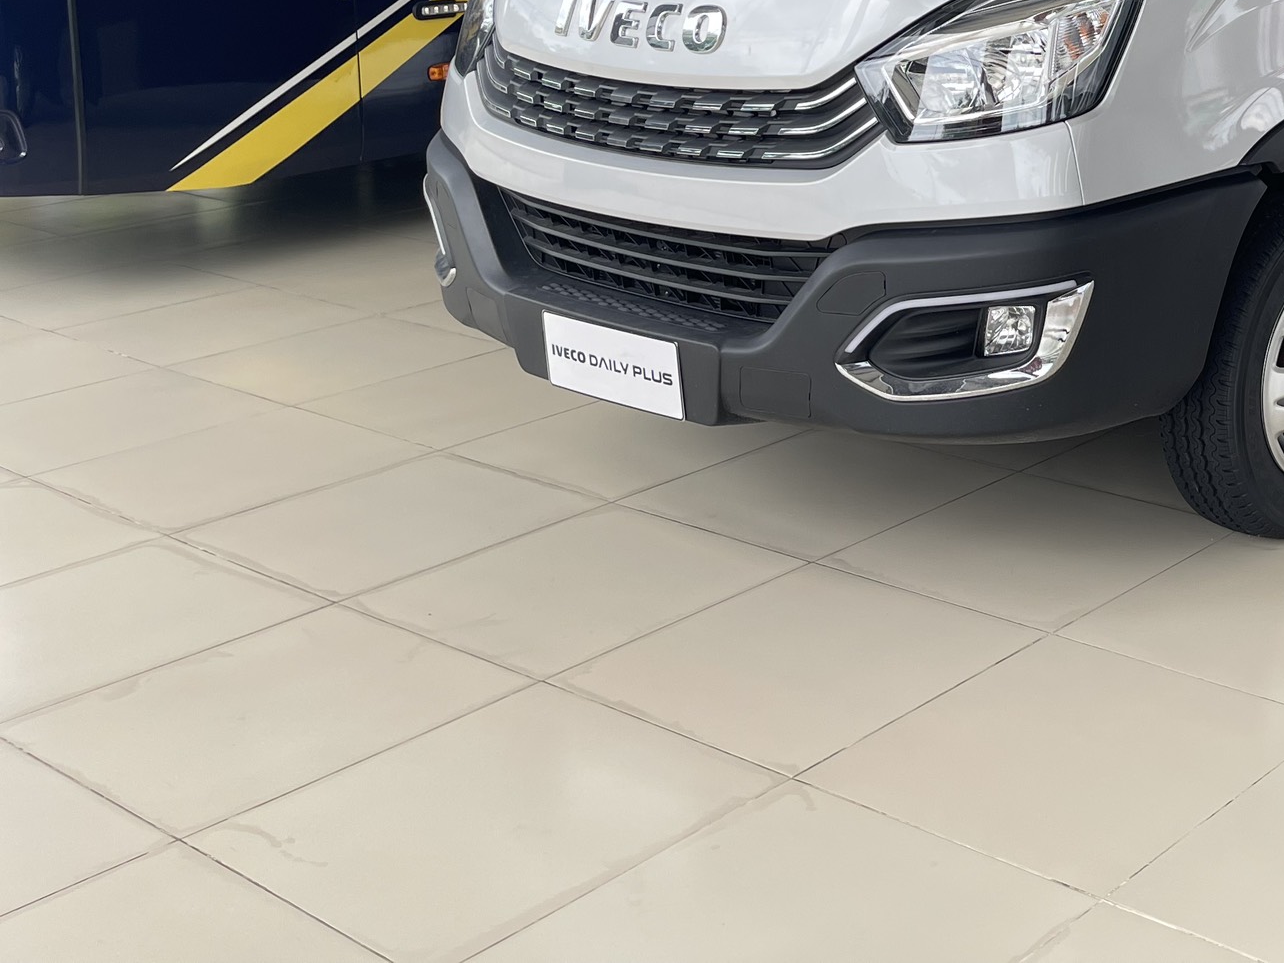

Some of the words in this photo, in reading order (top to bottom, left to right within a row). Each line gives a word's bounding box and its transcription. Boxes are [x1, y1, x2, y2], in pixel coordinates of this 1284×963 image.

[551, 343, 586, 364] IVECO
[588, 353, 629, 376] DAILY
[632, 365, 674, 387] PLUS
